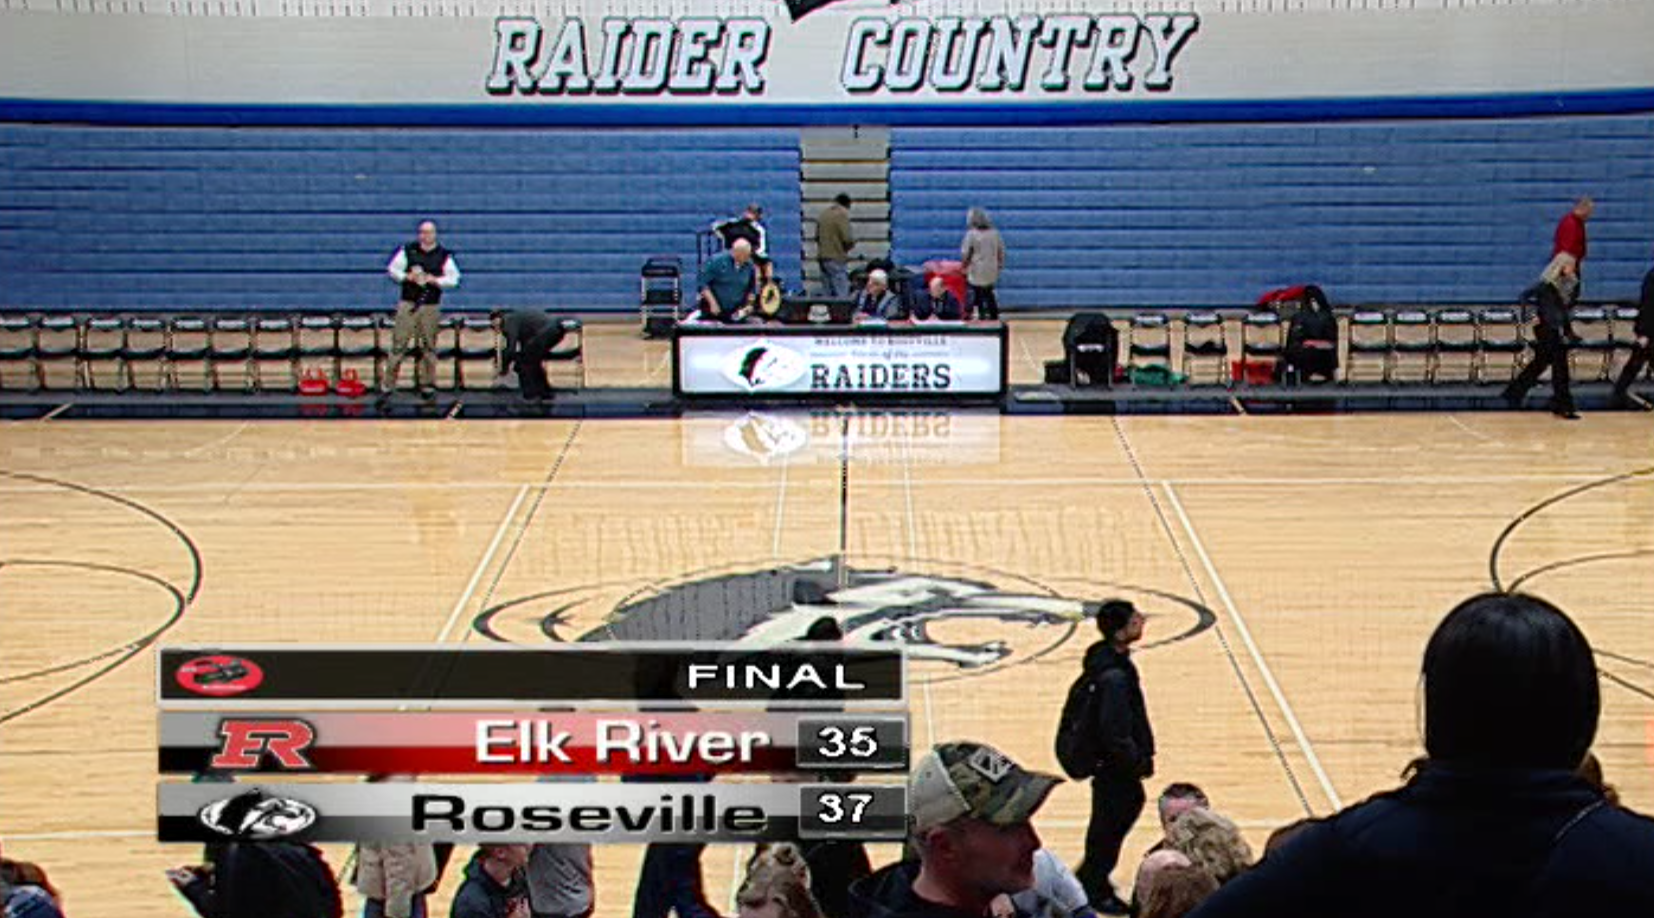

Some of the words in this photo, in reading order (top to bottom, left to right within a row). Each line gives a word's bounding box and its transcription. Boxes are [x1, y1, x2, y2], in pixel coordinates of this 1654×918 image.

[486, 16, 772, 95] RAIDER
[840, 14, 1200, 94] COUNTRY
[810, 363, 951, 389] RAIDERS
